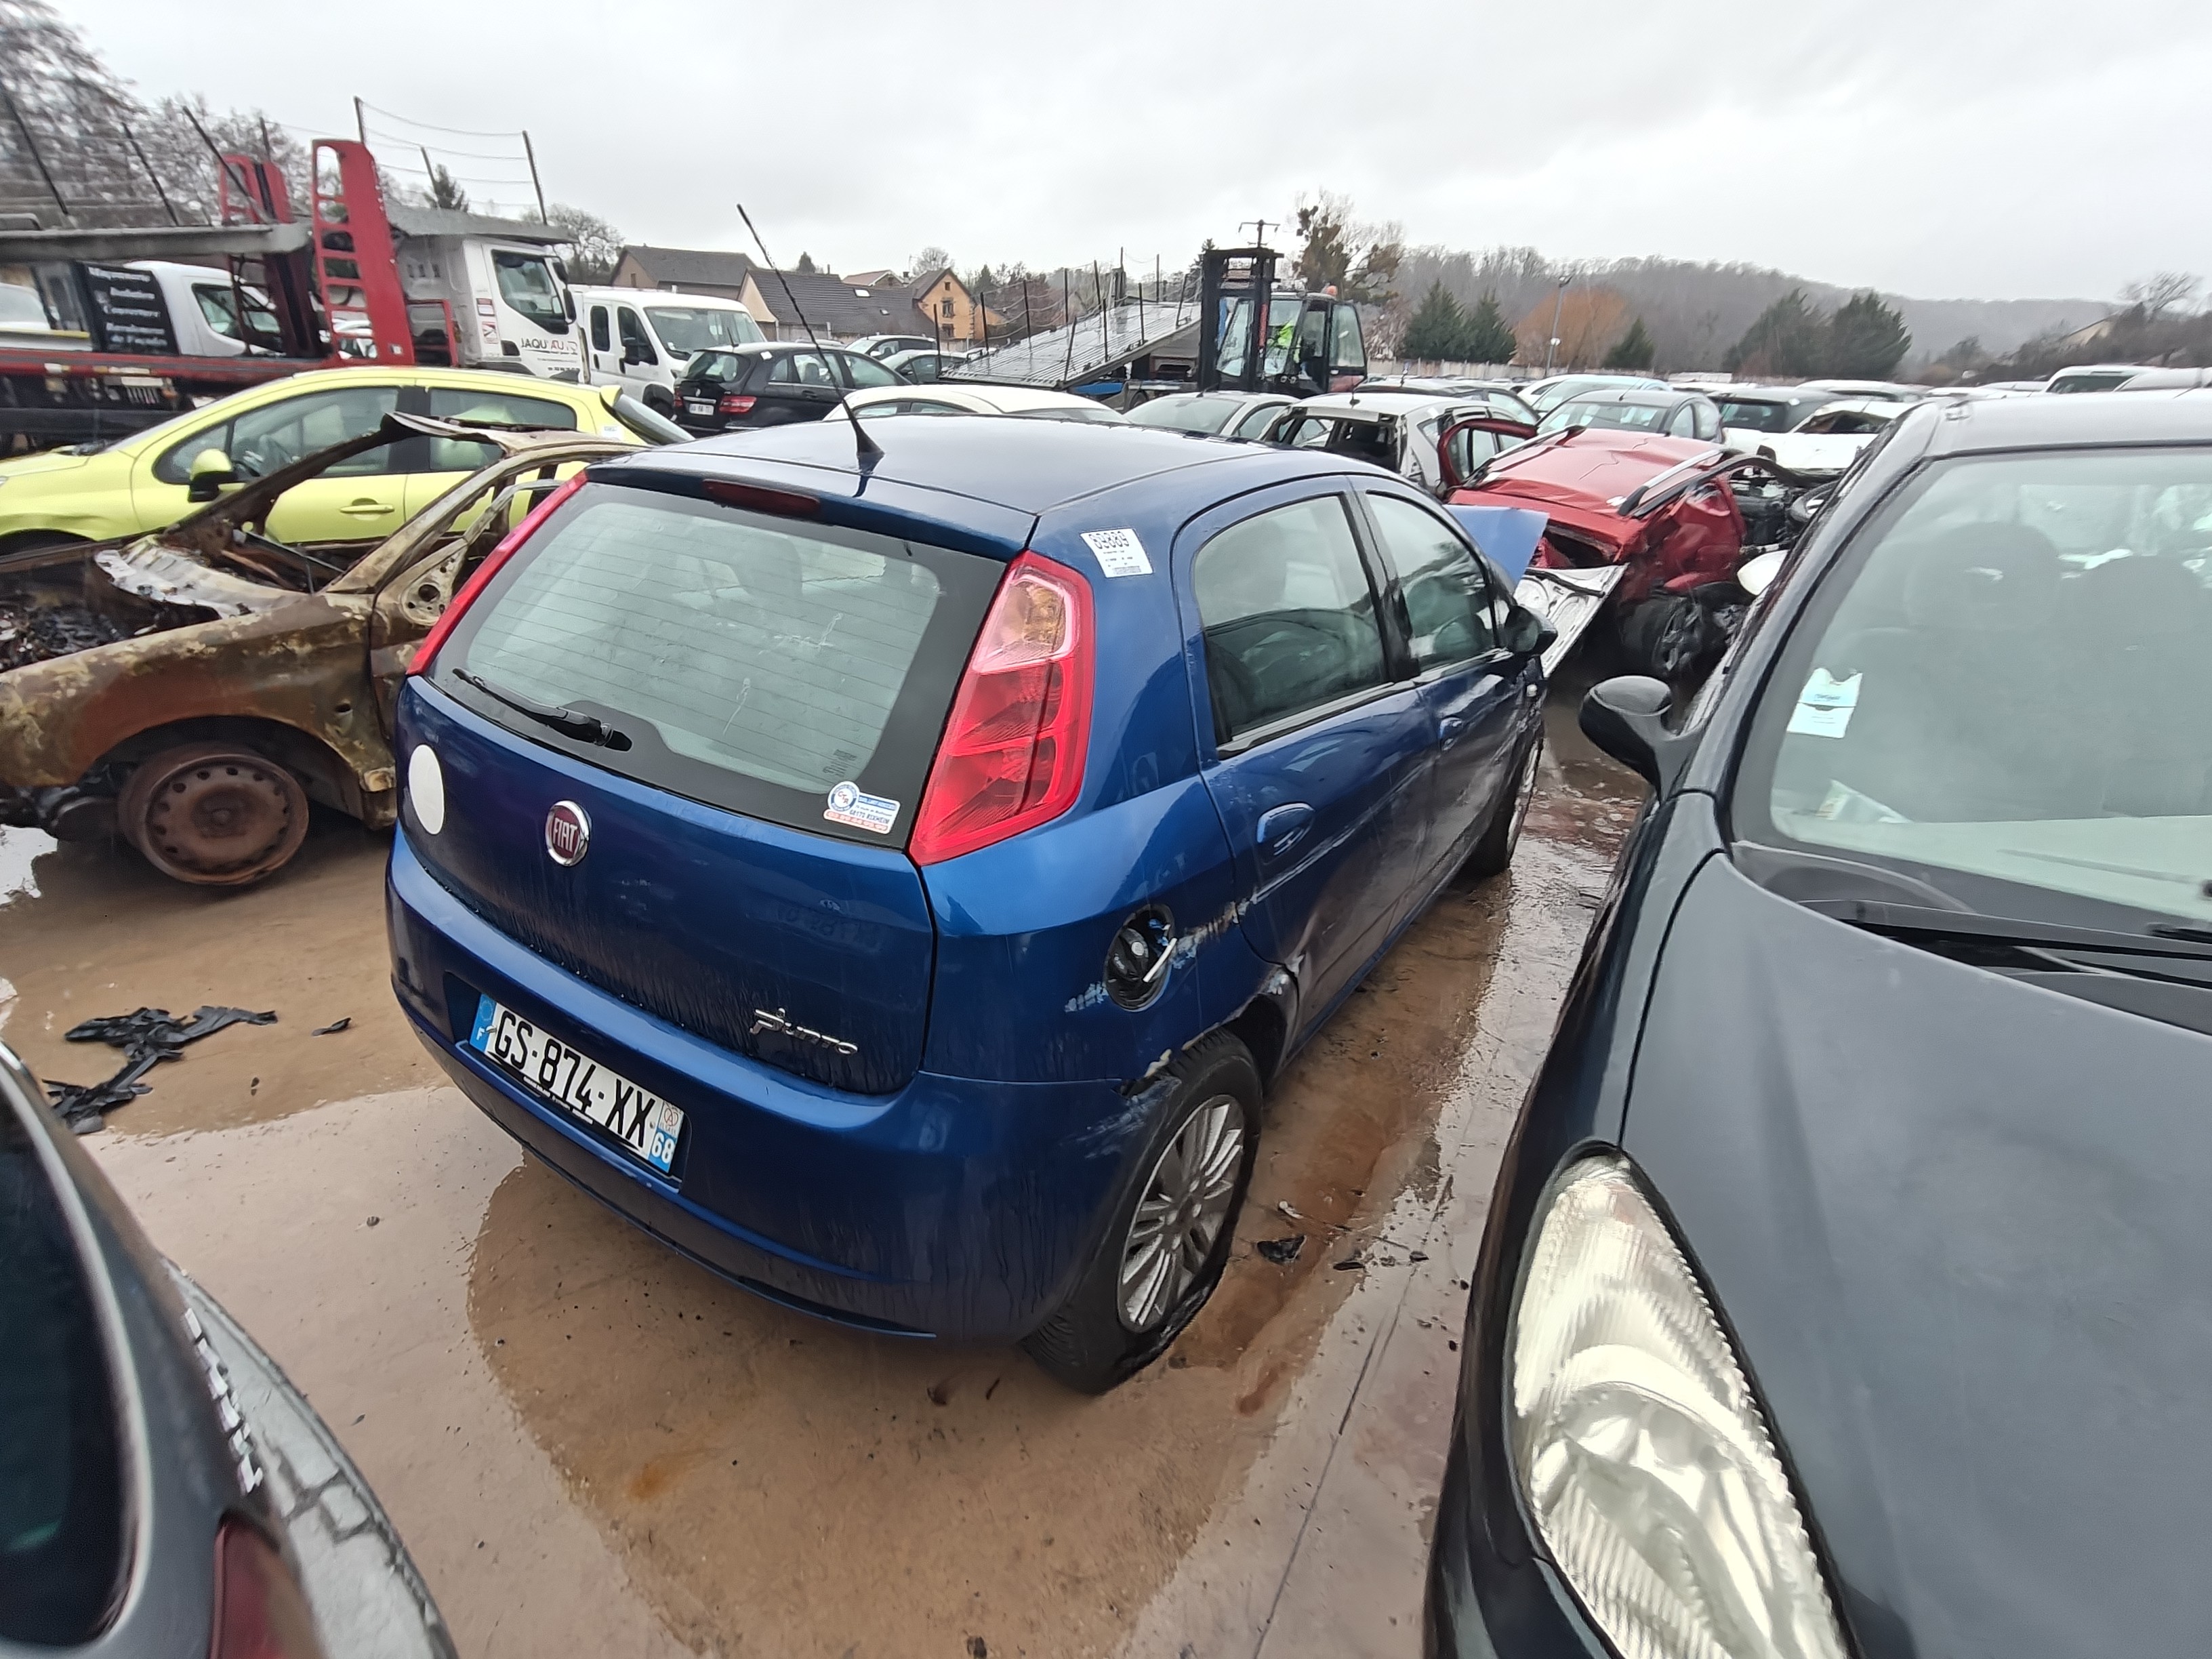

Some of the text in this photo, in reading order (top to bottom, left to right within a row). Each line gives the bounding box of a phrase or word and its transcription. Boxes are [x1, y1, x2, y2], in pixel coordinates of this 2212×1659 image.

[553, 817, 577, 852] FIAT
[476, 1027, 485, 1041] F
[651, 1132, 673, 1164] 68
